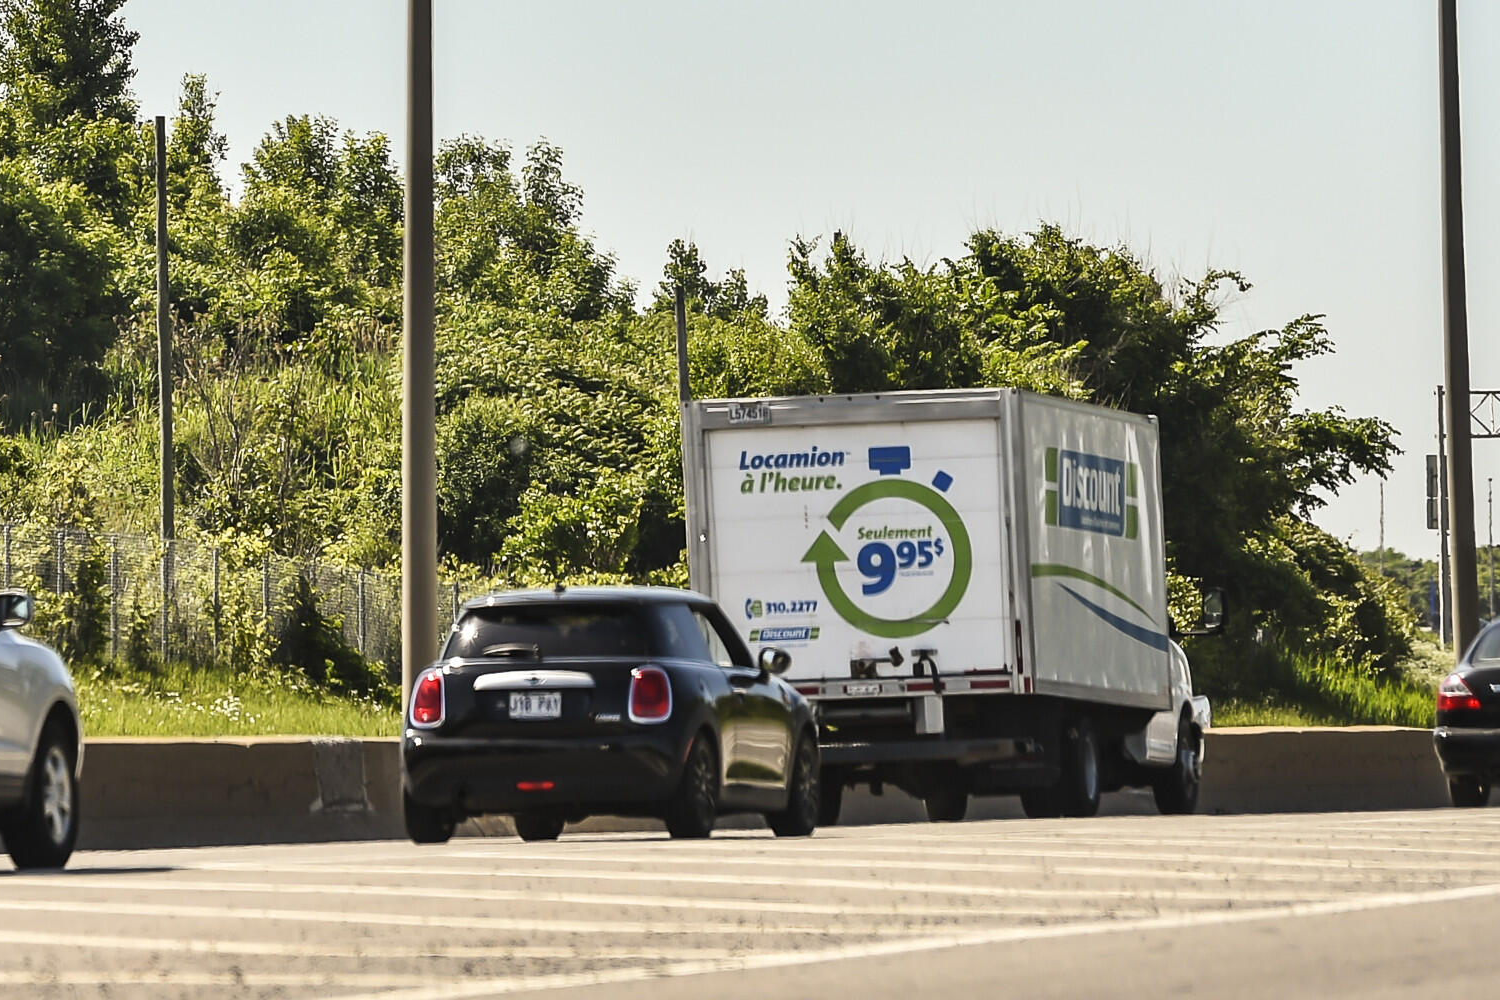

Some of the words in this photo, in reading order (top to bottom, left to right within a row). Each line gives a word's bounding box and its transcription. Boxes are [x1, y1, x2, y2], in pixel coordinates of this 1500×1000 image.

[739, 446, 845, 470] Locamion
[740, 473, 755, 494] à
[1062, 457, 1121, 517] Discount
[857, 526, 933, 540] Seulement
